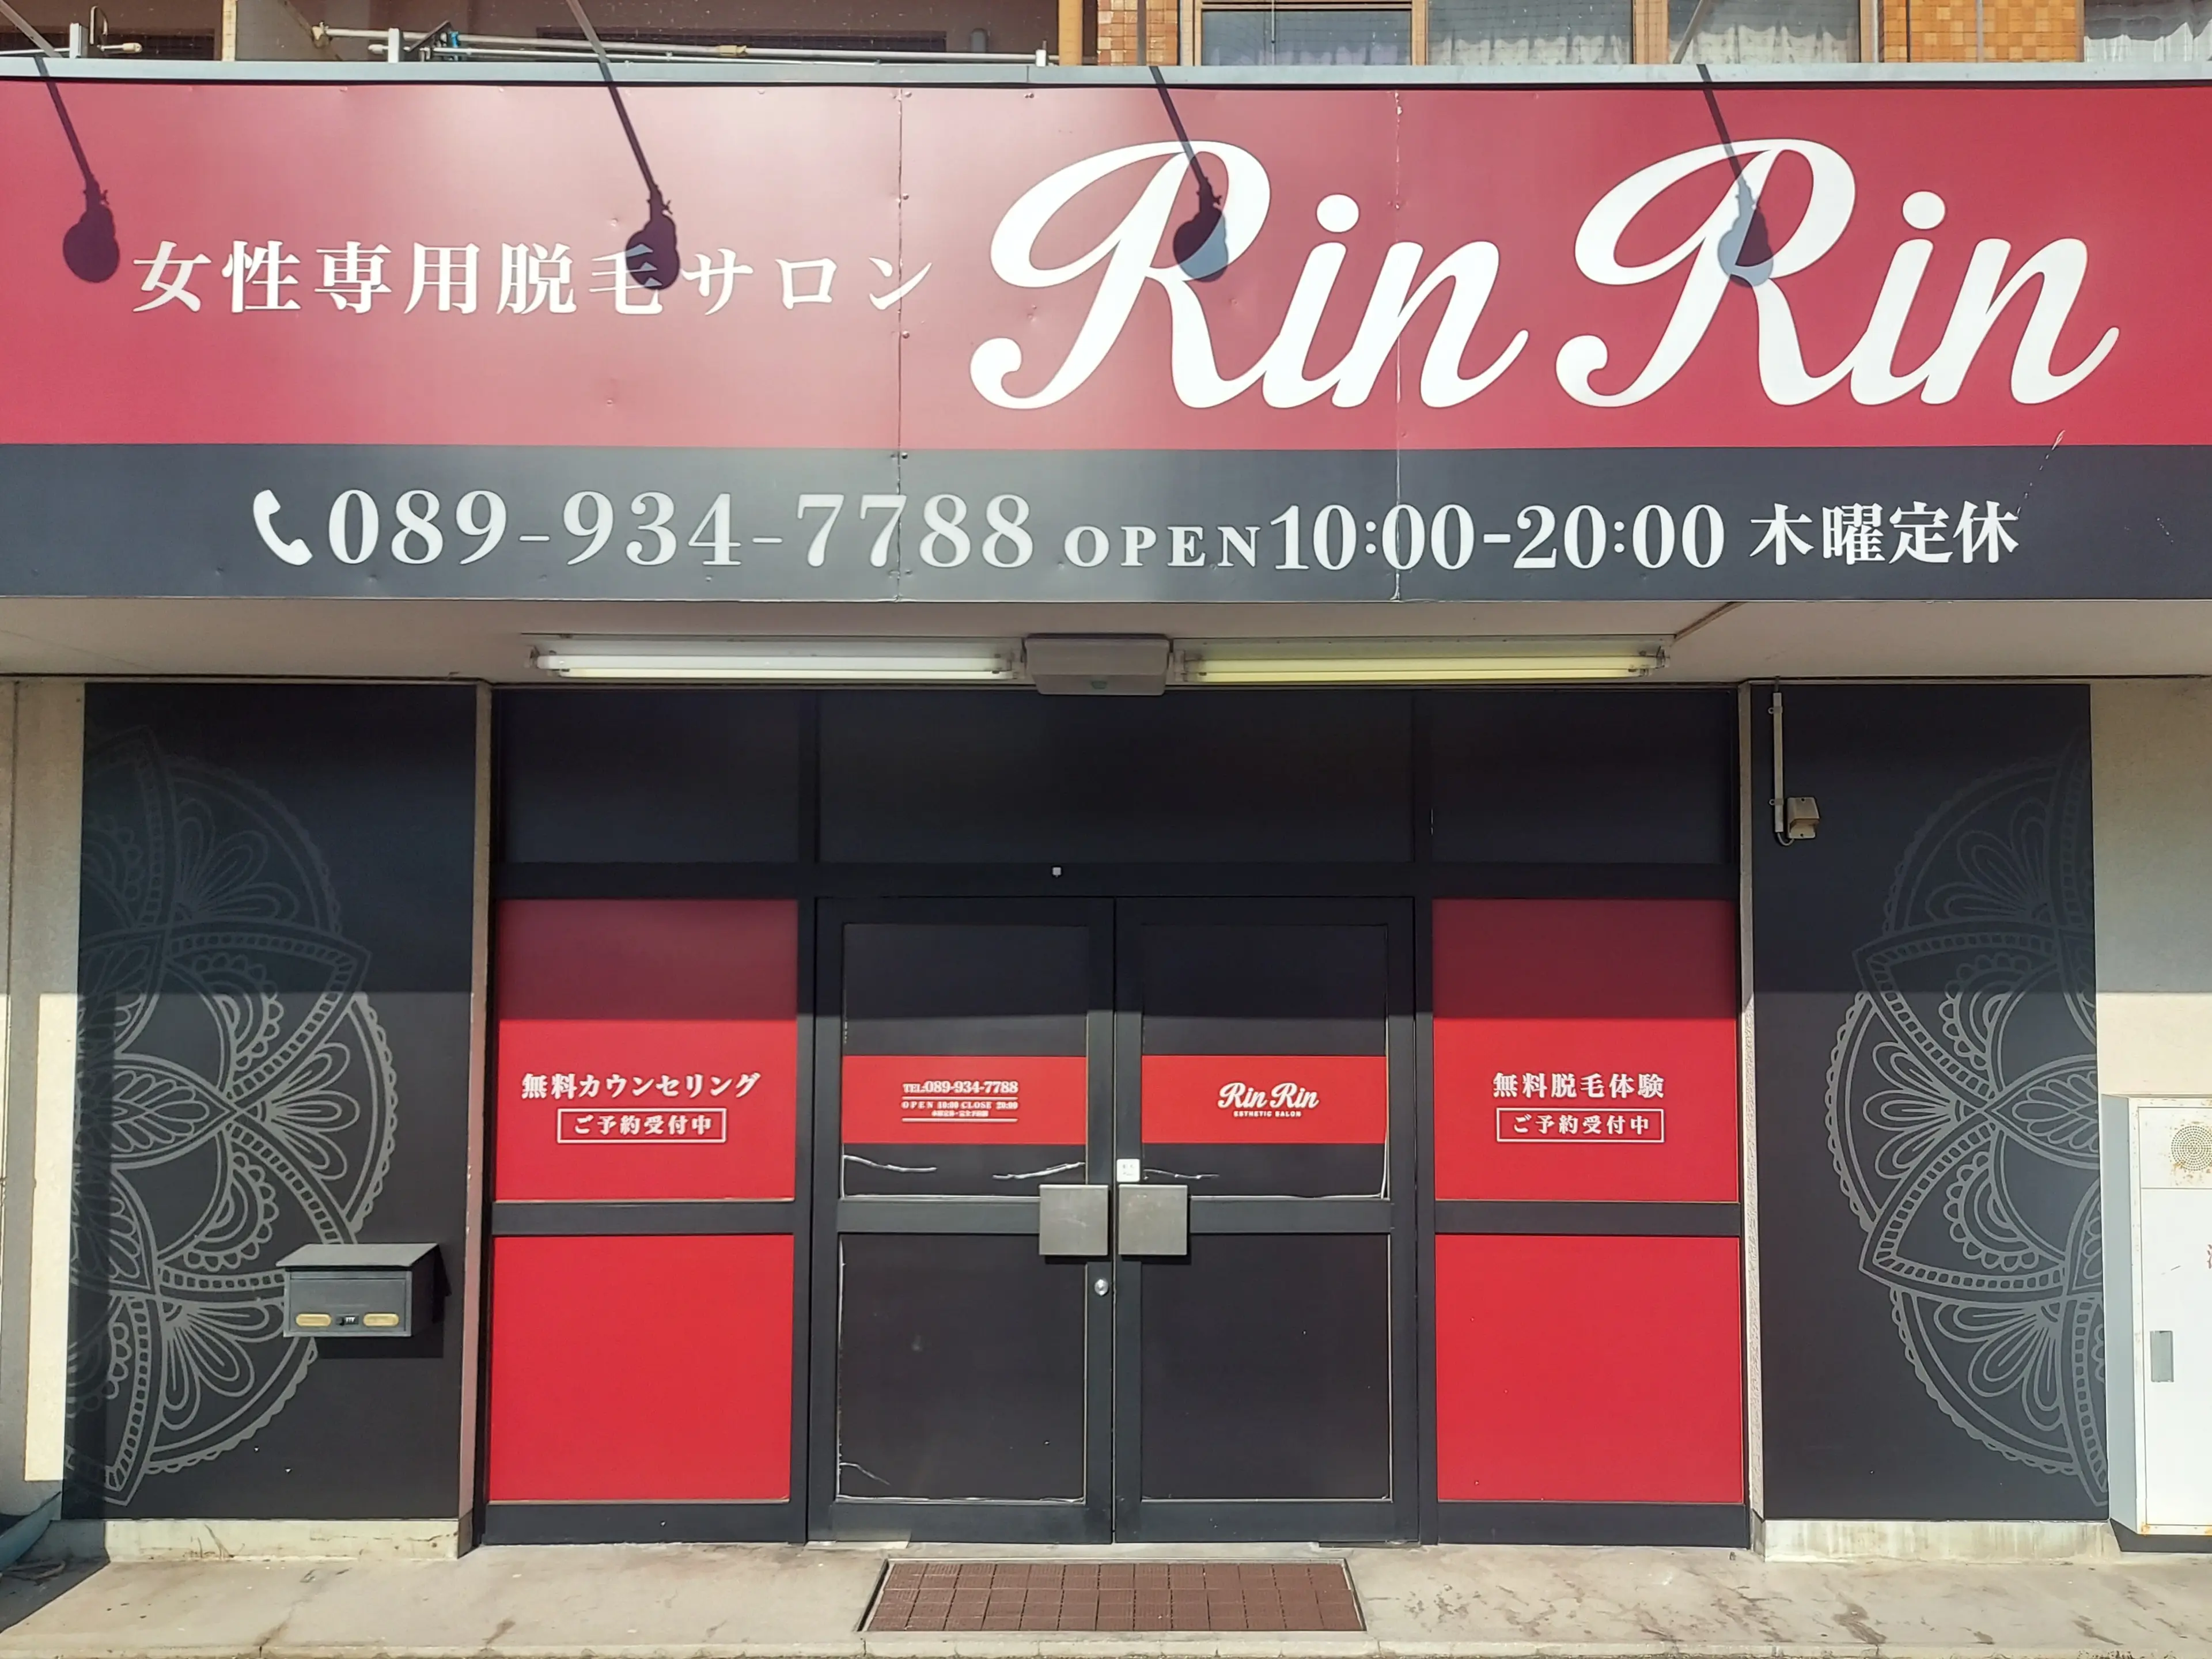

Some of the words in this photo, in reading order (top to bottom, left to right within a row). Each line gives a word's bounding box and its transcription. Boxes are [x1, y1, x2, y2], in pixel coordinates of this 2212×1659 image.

[133, 239, 933, 315] 女性専用脱毛サロン
[970, 141, 1529, 409] Rin
[1556, 139, 2119, 407] Rin
[329, 490, 1033, 568] 089-934-7788
[1064, 525, 1261, 567] OPEN
[1270, 504, 1725, 570] 10:00-20:00
[1749, 500, 2020, 566] 木曜定休
[521, 1073, 761, 1099] 無料カウンセリング
[1218, 1082, 1267, 1108] Rin
[1270, 1083, 1319, 1108] Rin
[1493, 1072, 1664, 1098] 無料脱毛体験
[575, 1115, 712, 1135] ご予約受付中
[1514, 1114, 1649, 1134] ご予約受付中
